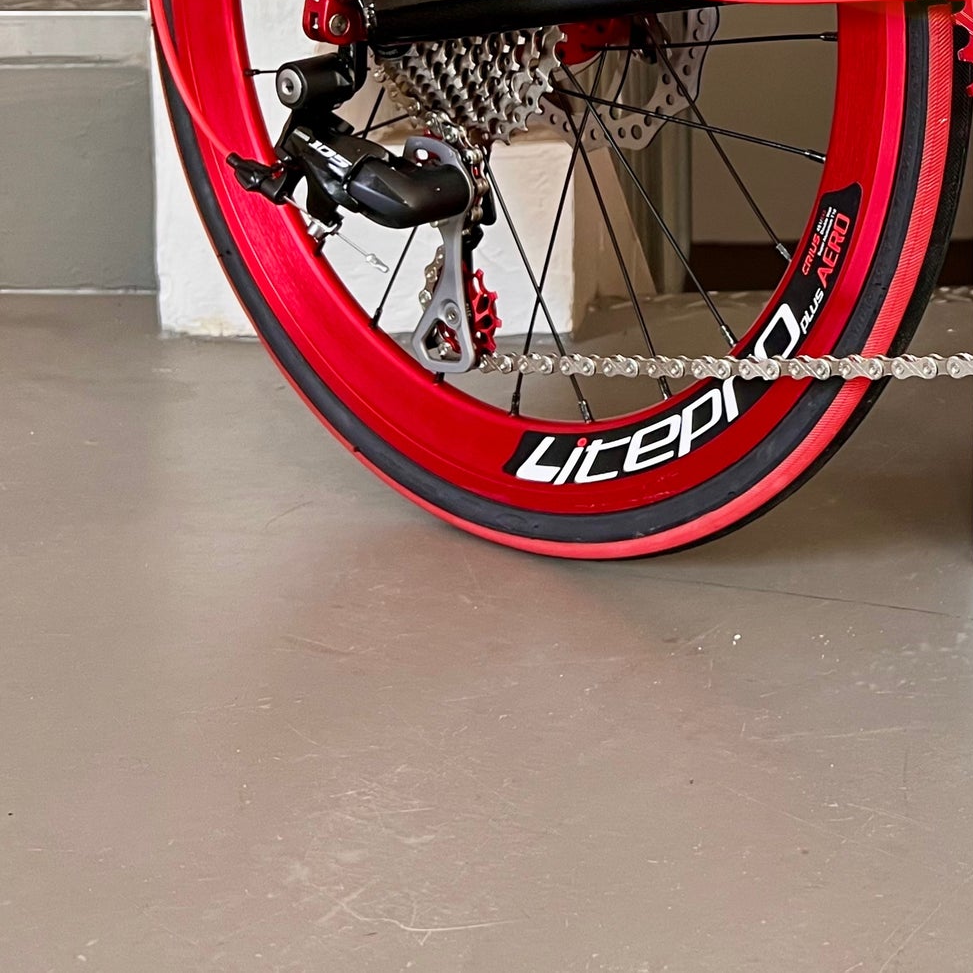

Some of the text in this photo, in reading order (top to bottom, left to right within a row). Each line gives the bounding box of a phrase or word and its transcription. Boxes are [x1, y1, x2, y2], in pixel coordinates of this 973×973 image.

[309, 139, 352, 169] 105
[802, 233, 820, 276] CRIUS
[817, 212, 850, 289] AERO
